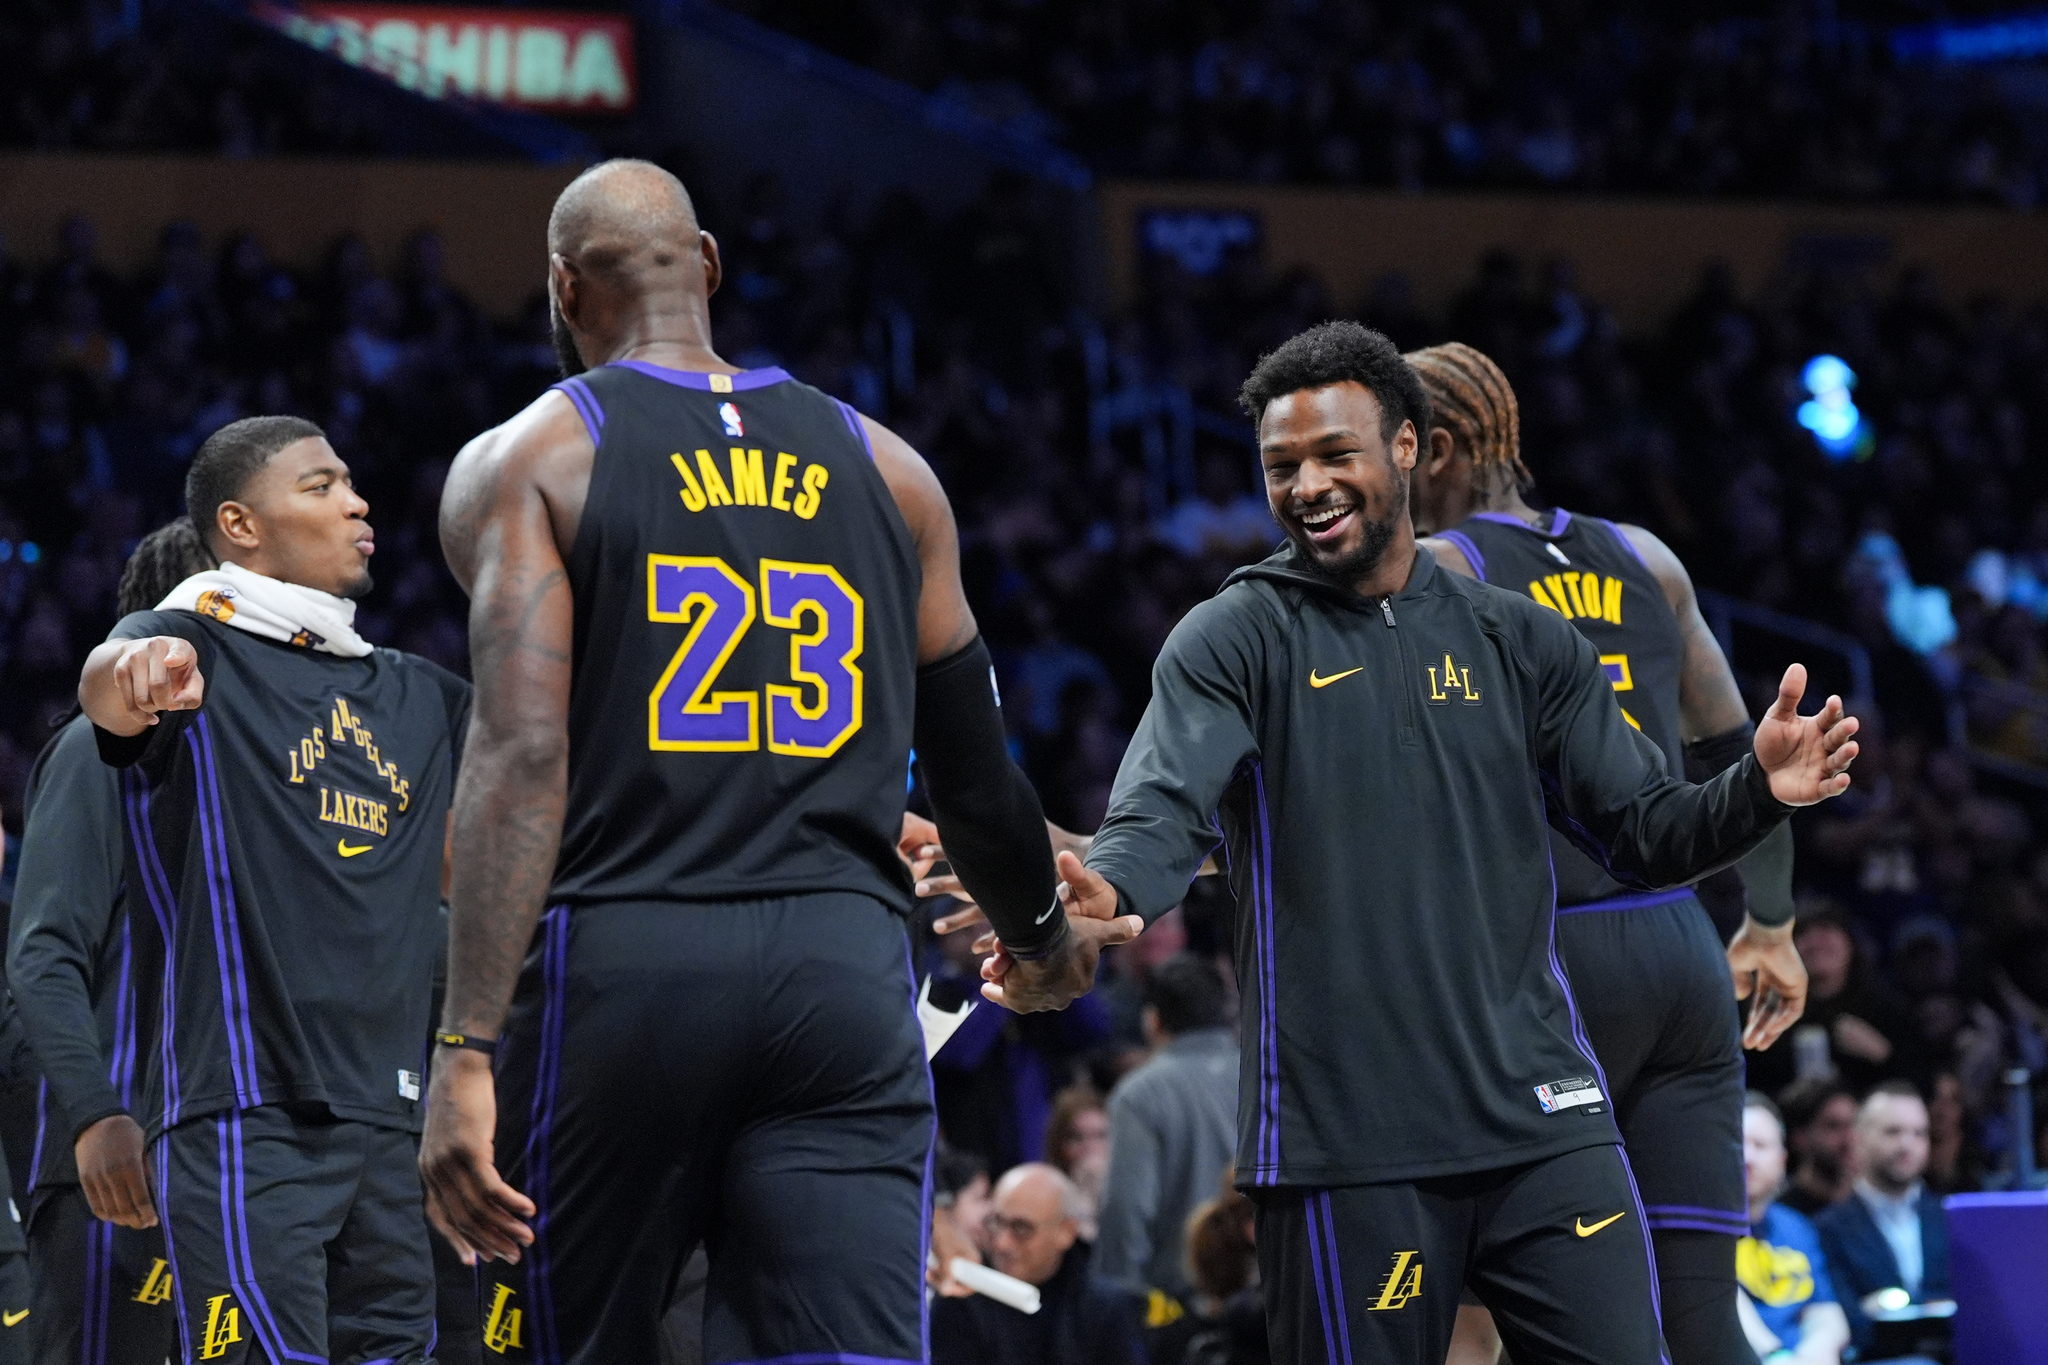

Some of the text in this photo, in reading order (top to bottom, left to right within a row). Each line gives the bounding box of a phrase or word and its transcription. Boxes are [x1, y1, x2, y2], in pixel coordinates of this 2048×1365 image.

[285, 15, 629, 104] OSHIBA
[670, 447, 829, 520] JAMES
[647, 553, 864, 758] 23
[1428, 654, 1479, 700] LAL
[289, 697, 409, 812] LOS ANGELES
[319, 788, 388, 837] LAKERS
[131, 1257, 173, 1305] LA
[1367, 1250, 1423, 1311] LA
[197, 1294, 242, 1360] LA
[482, 1282, 524, 1354] LA
